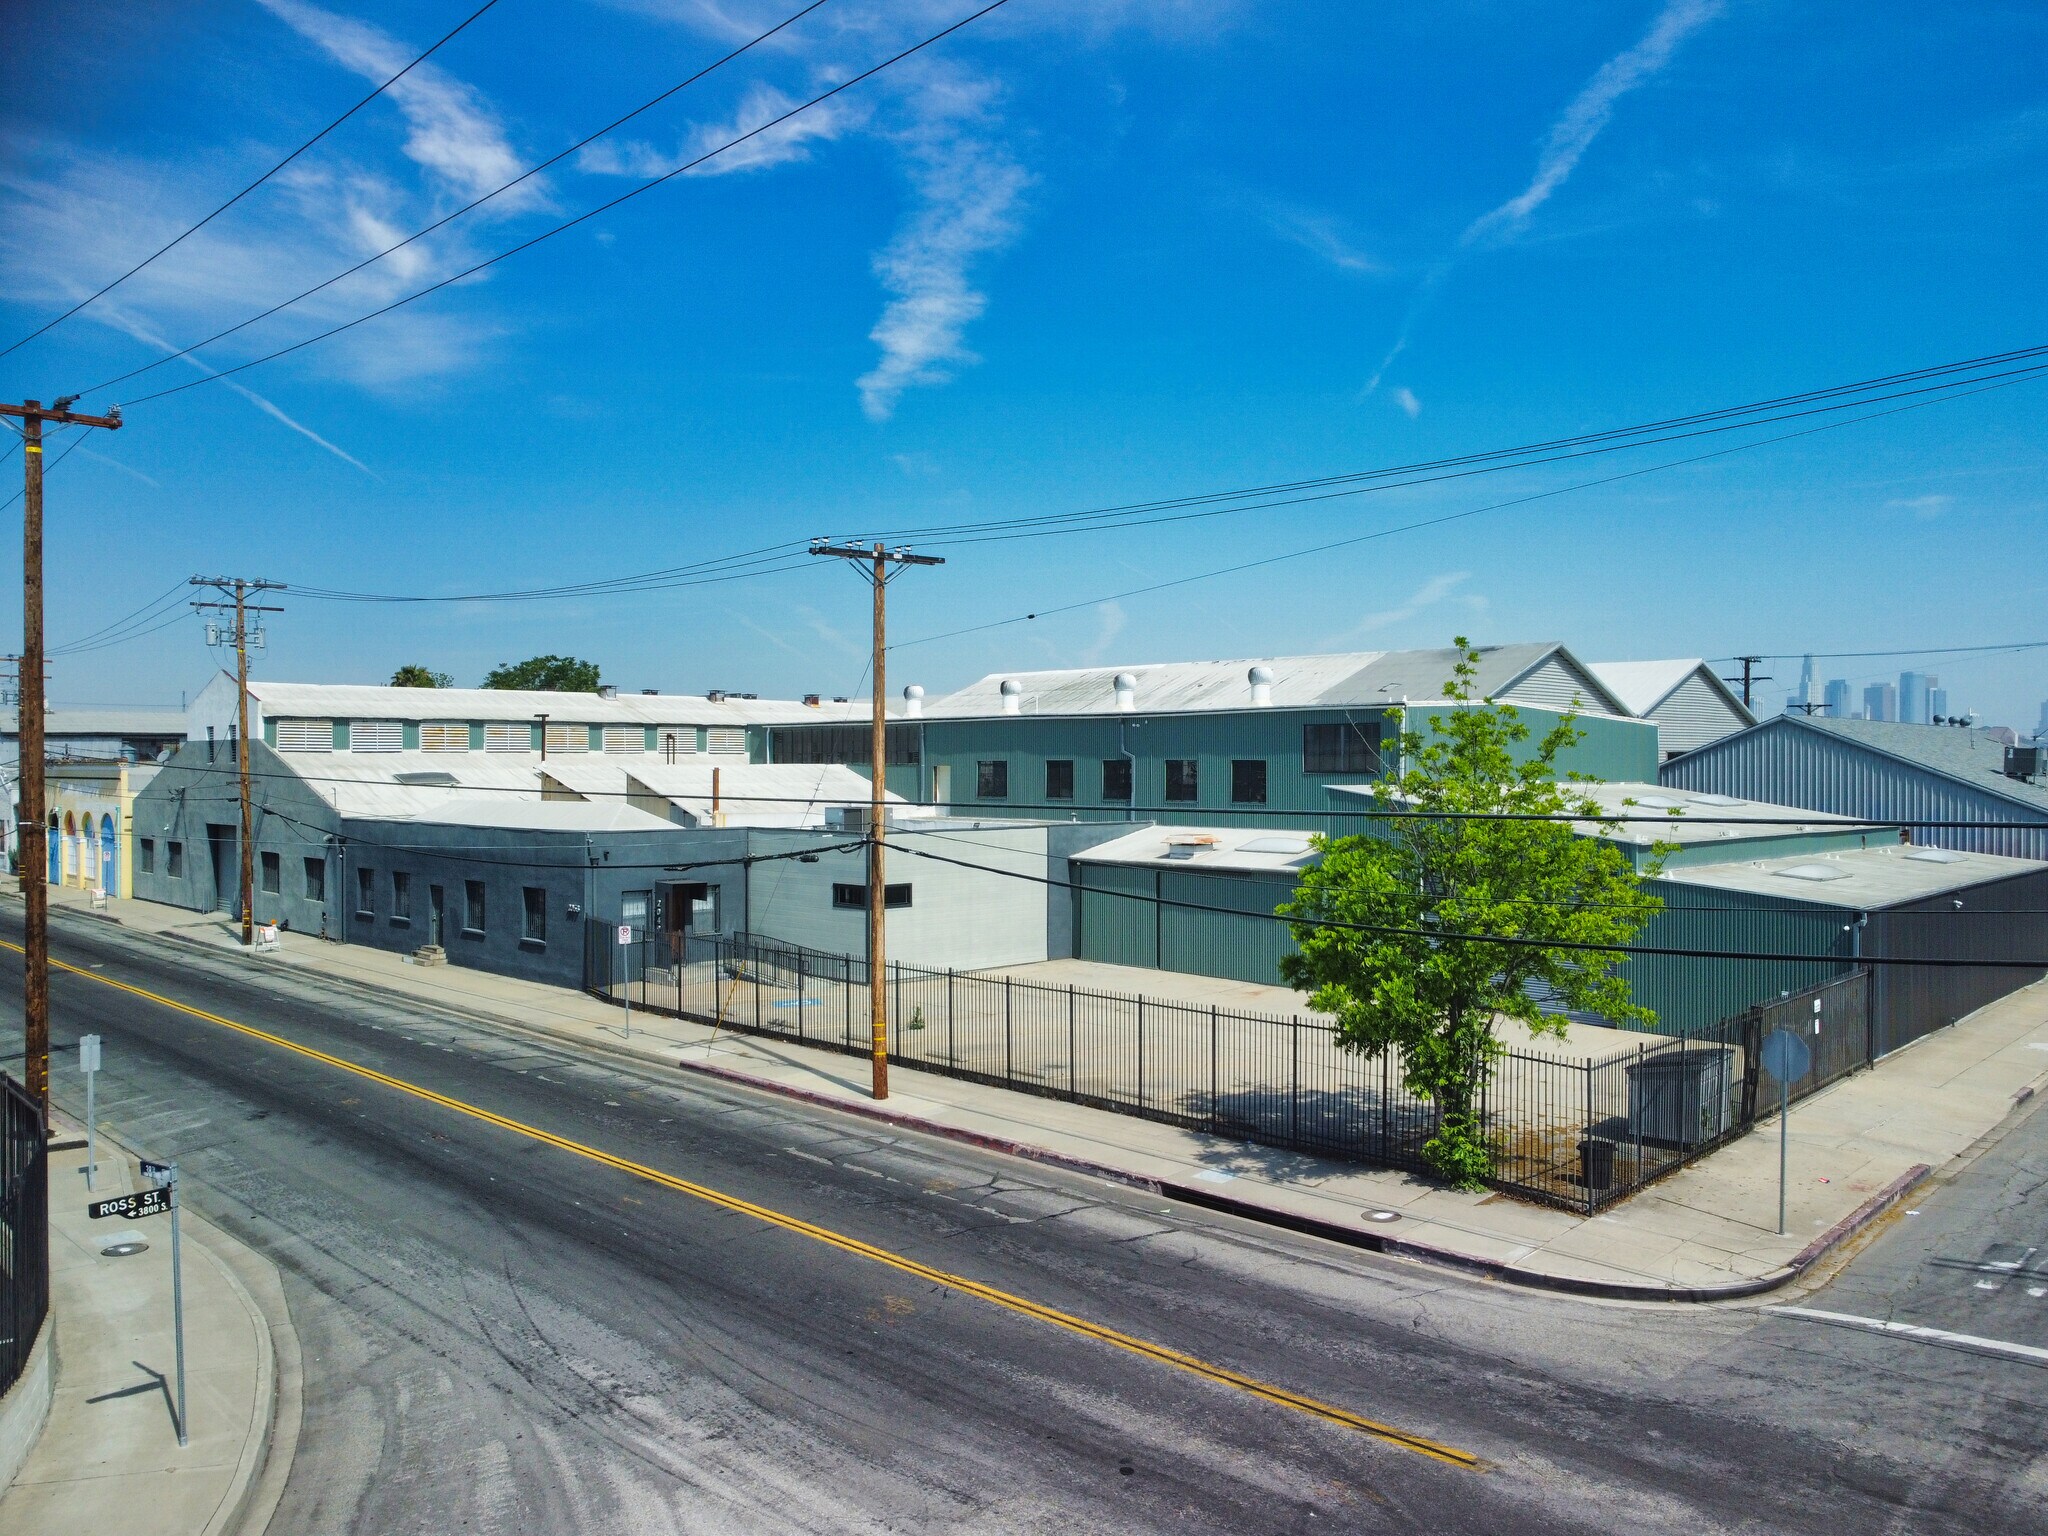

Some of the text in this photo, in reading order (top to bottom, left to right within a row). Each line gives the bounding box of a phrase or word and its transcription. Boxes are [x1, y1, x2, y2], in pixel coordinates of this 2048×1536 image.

[100, 1191, 161, 1216] ROSS ST.
[138, 1204, 159, 1216] 3800
